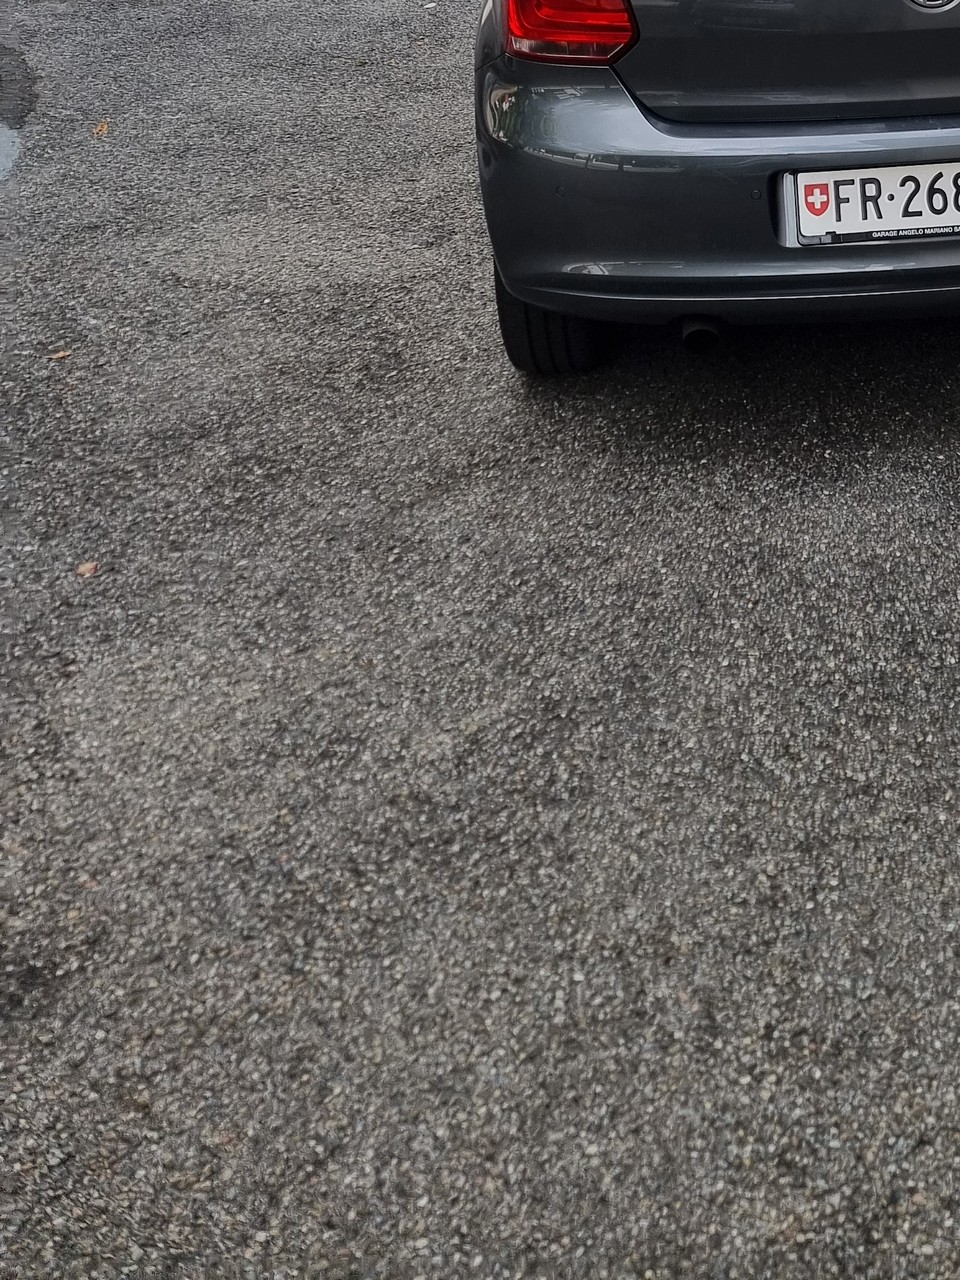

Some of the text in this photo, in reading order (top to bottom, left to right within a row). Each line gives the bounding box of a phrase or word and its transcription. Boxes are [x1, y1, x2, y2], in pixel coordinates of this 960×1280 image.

[872, 230, 898, 238] GARAGE
[899, 228, 924, 236] ANGELO
[924, 226, 953, 234] MARIANO
